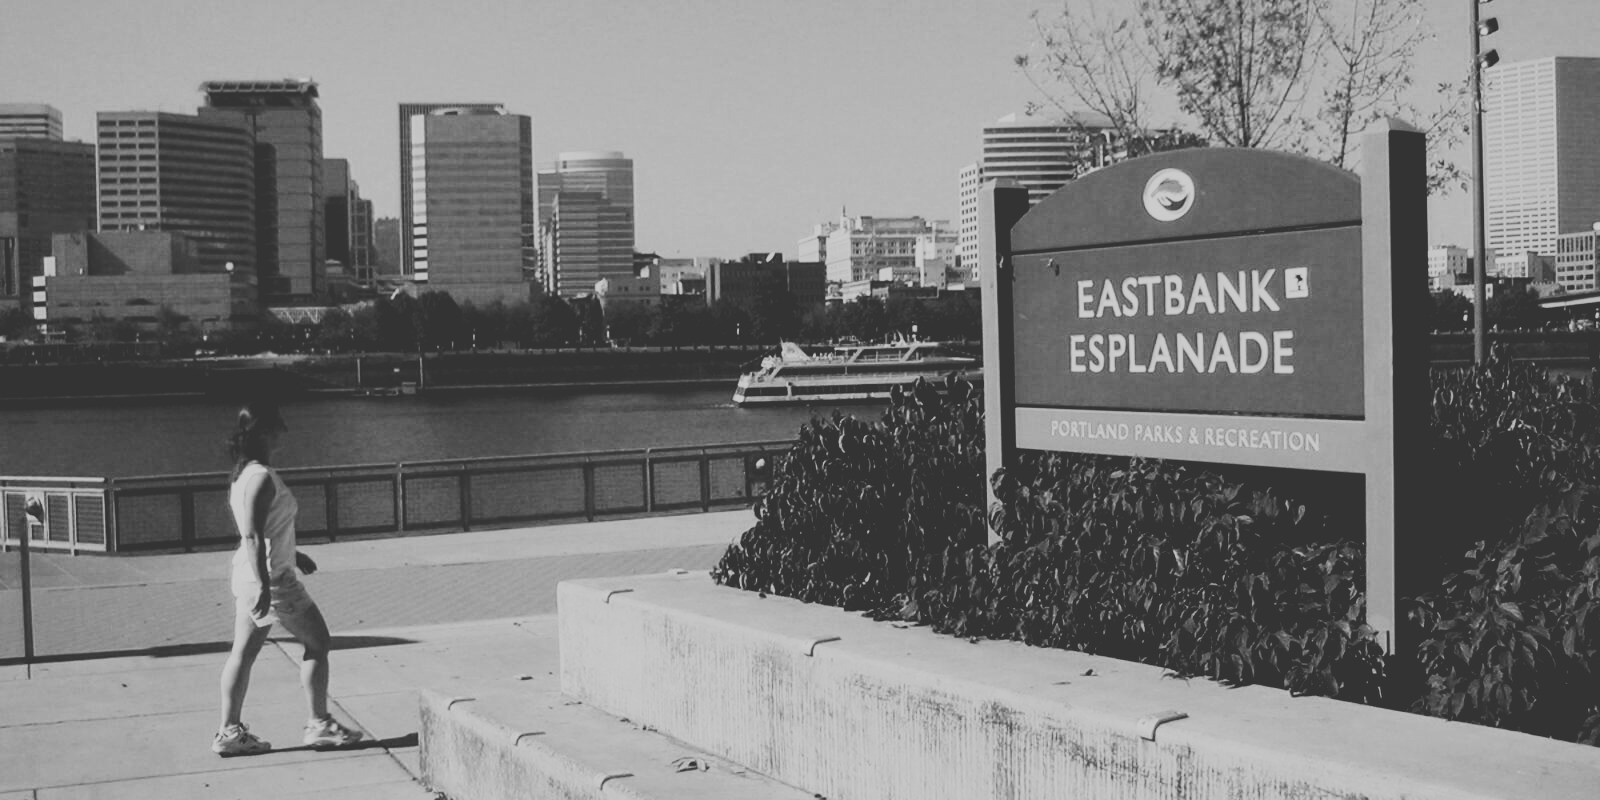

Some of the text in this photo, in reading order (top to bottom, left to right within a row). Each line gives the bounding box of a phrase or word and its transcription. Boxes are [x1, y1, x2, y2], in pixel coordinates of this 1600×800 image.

[1077, 269, 1280, 318] EASTBANK
[1070, 330, 1294, 374] ESPLANADE
[1051, 420, 1320, 452] PORTLAND PARKS & RECREATION
